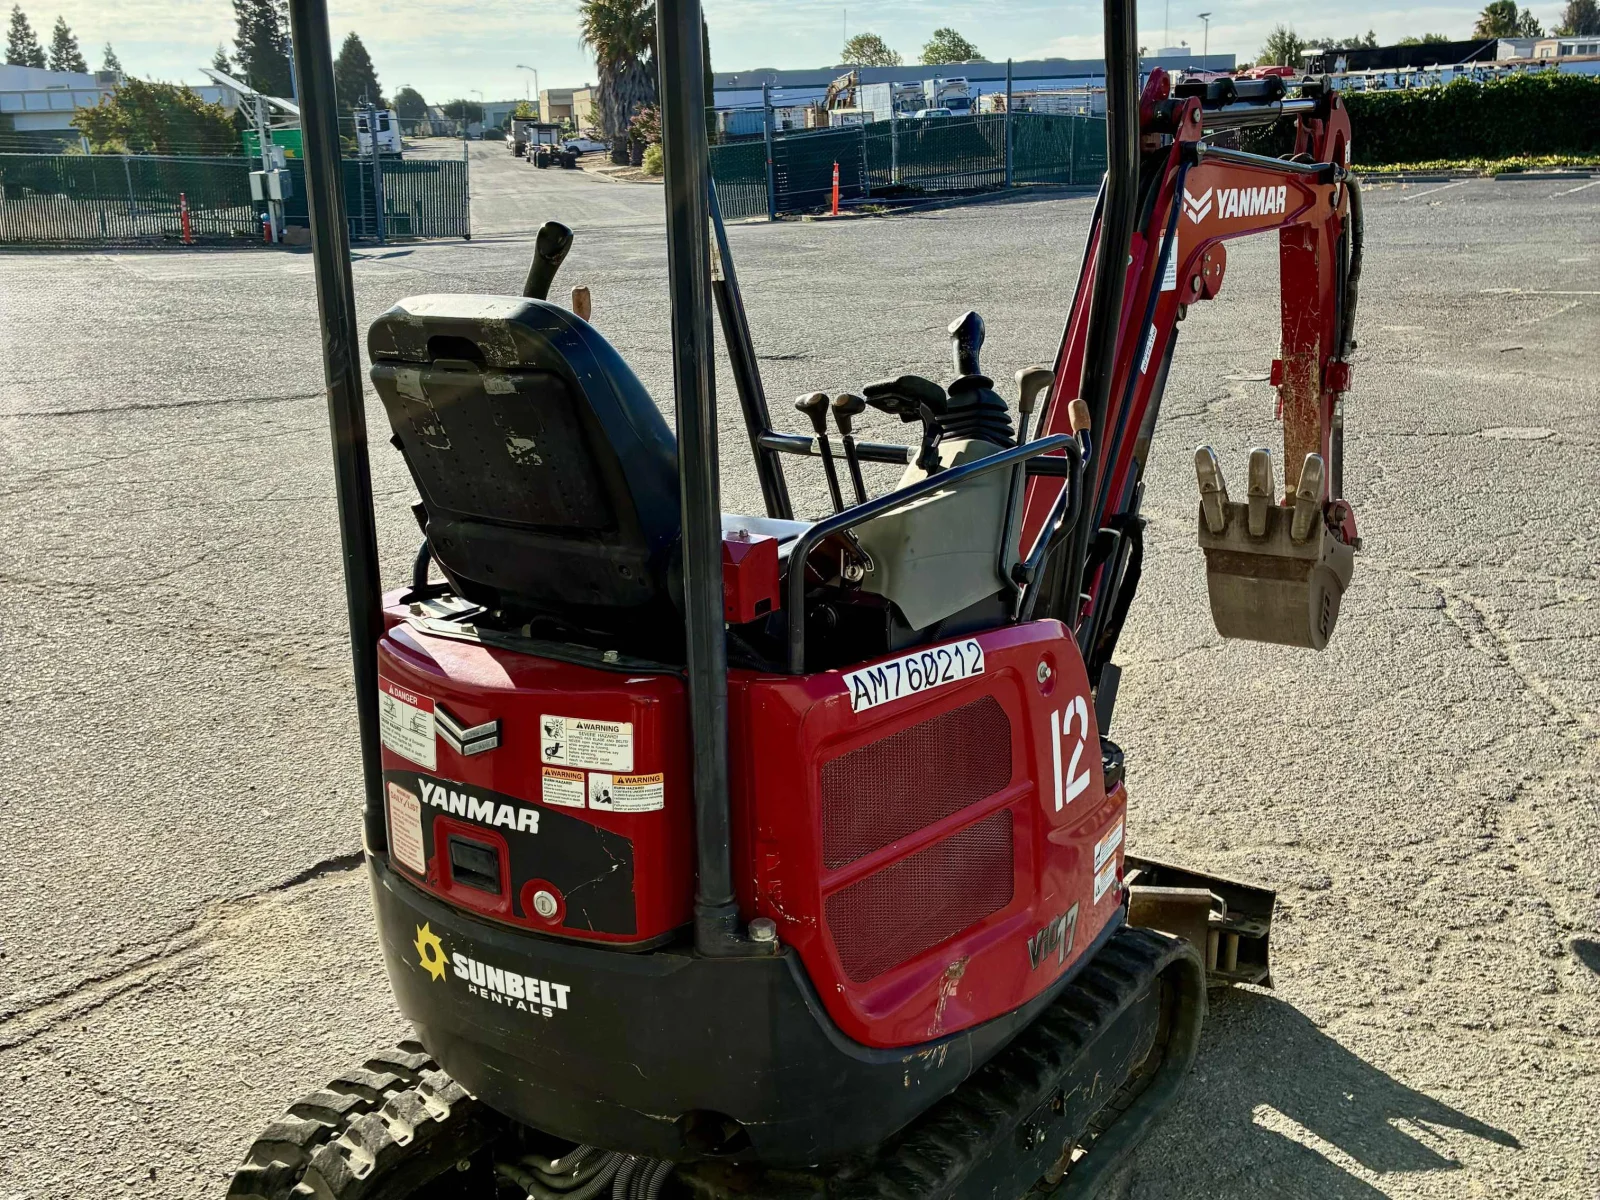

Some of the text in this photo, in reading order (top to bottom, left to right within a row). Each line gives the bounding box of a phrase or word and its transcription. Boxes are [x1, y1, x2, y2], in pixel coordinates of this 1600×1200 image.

[1216, 185, 1287, 219] YANMAR
[852, 641, 984, 711] AM760212
[395, 688, 418, 706] DANGER
[583, 723, 619, 733] WARNING
[1050, 695, 1091, 812] 12
[551, 769, 582, 780] WARNING
[625, 775, 660, 784] WARNING
[418, 778, 540, 834] YANMAR
[452, 952, 571, 1010] SUNBELT
[468, 984, 554, 1018] RENTALS
